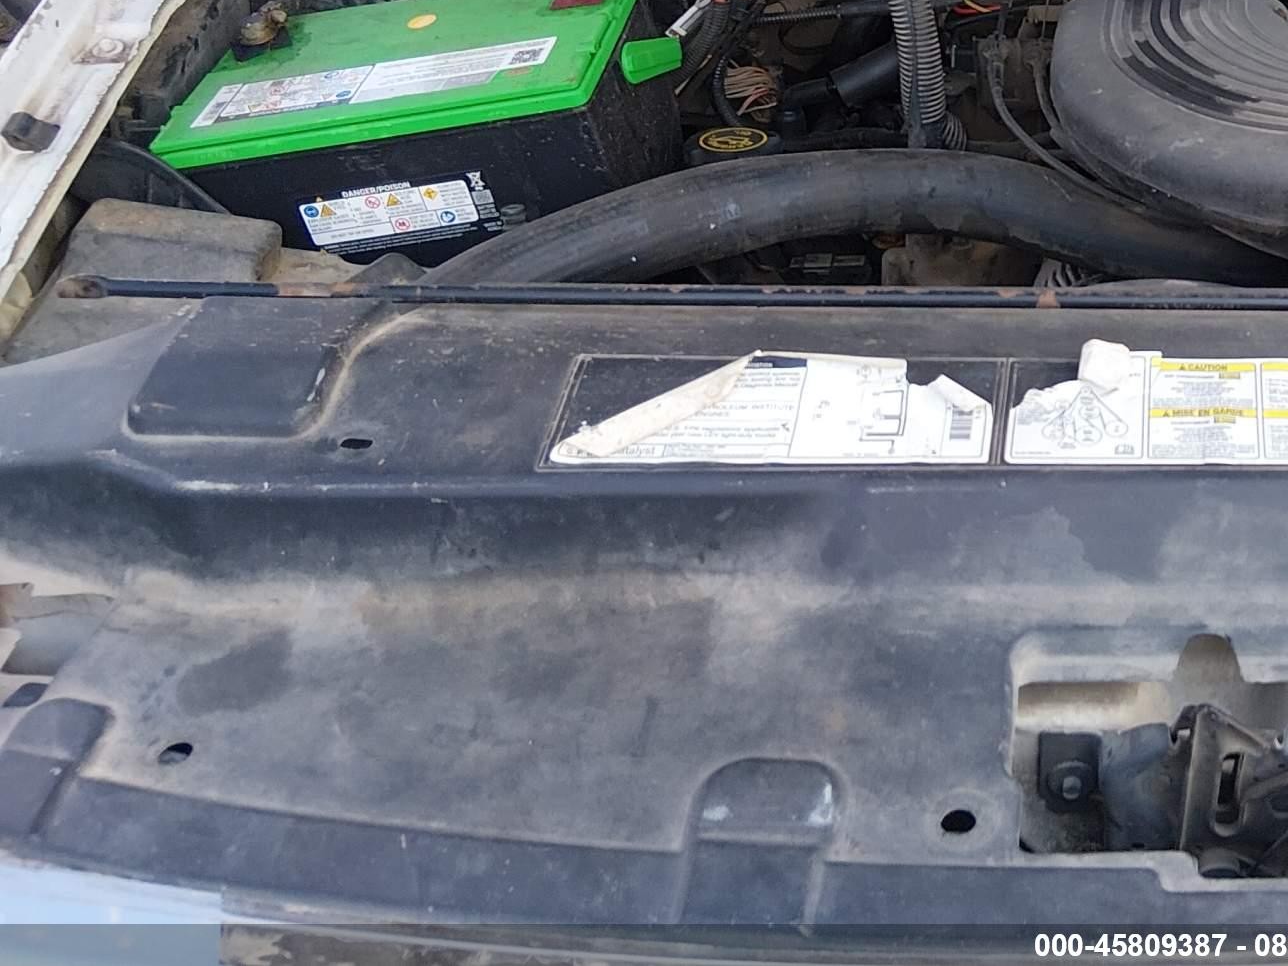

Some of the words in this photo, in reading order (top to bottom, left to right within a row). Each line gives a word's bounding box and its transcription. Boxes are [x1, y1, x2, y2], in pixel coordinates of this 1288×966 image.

[341, 181, 412, 198] DANGER/POISON
[1187, 363, 1228, 371] CAUTION
[1198, 409, 1210, 417] EN
